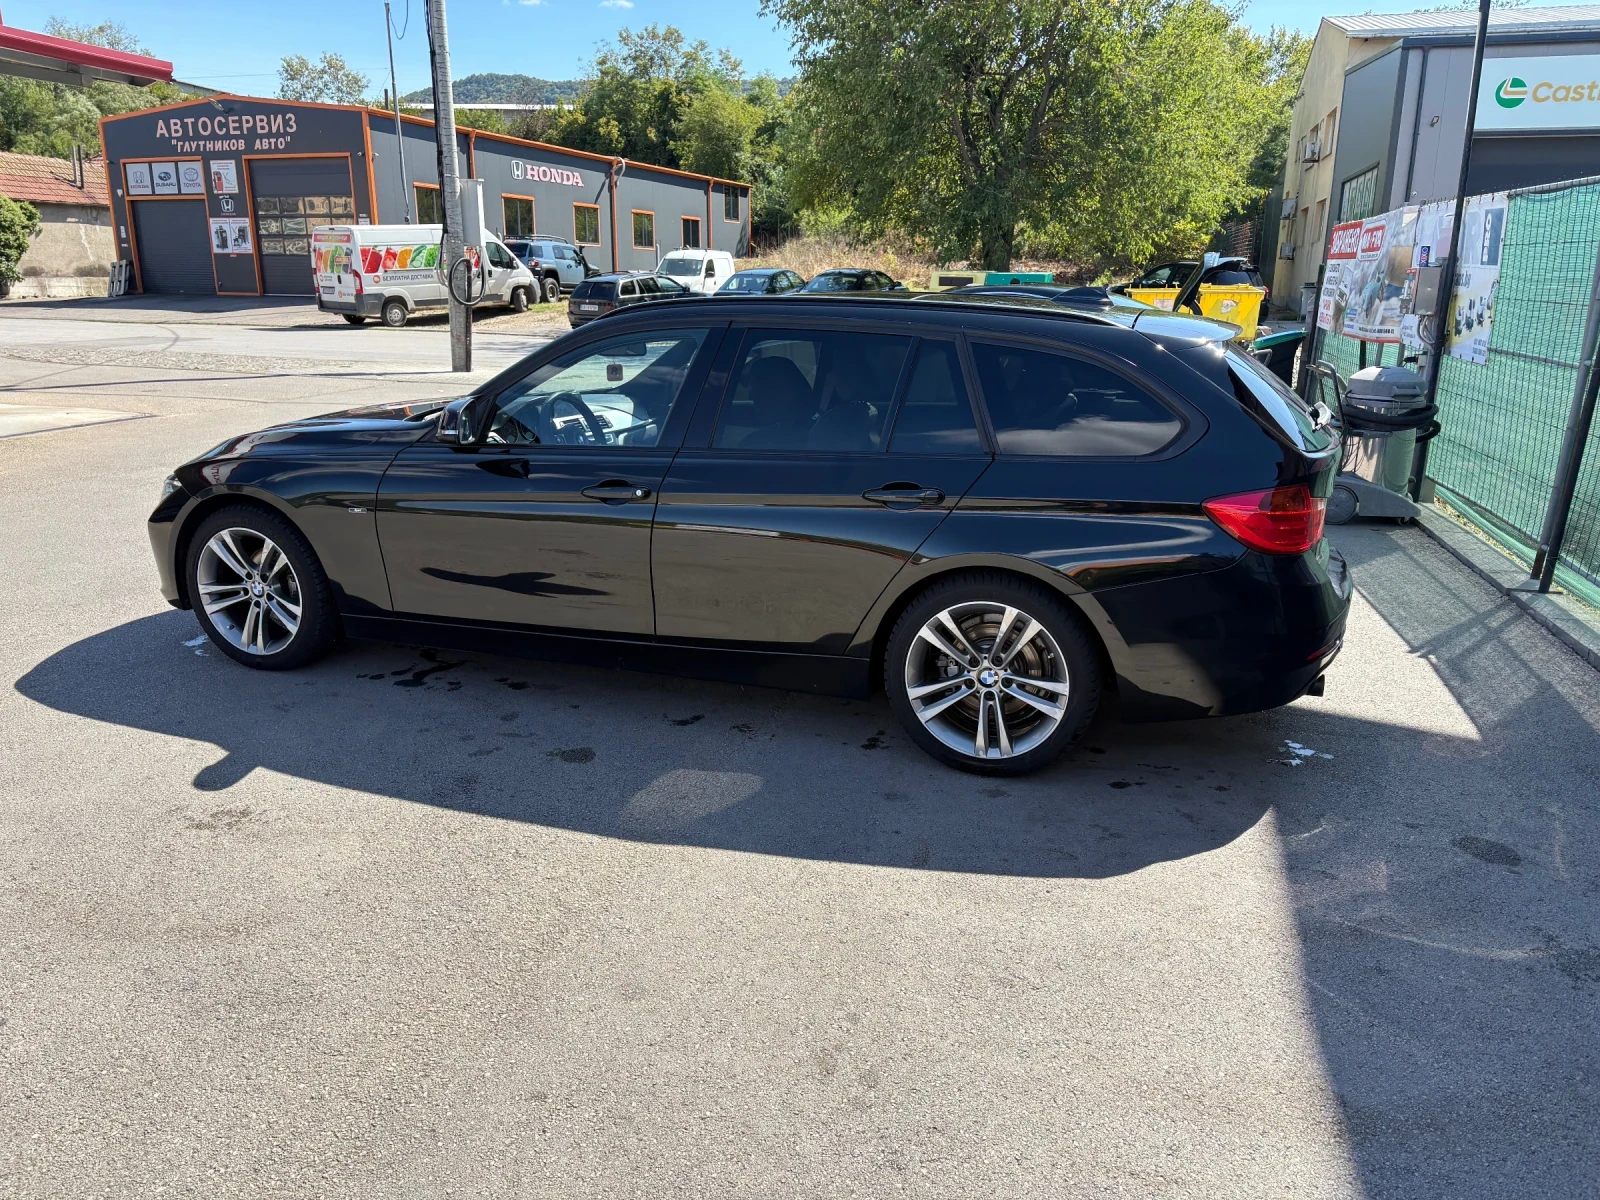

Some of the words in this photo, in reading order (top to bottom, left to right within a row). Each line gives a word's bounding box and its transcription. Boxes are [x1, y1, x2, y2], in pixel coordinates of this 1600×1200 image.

[1532, 80, 1600, 103] Cast
[156, 113, 297, 138] АВТОСЕРВИЗ
[172, 139, 245, 152] "ГЛУТНИКОВ
[254, 136, 291, 150] АВТО"
[525, 164, 584, 187] HONDA
